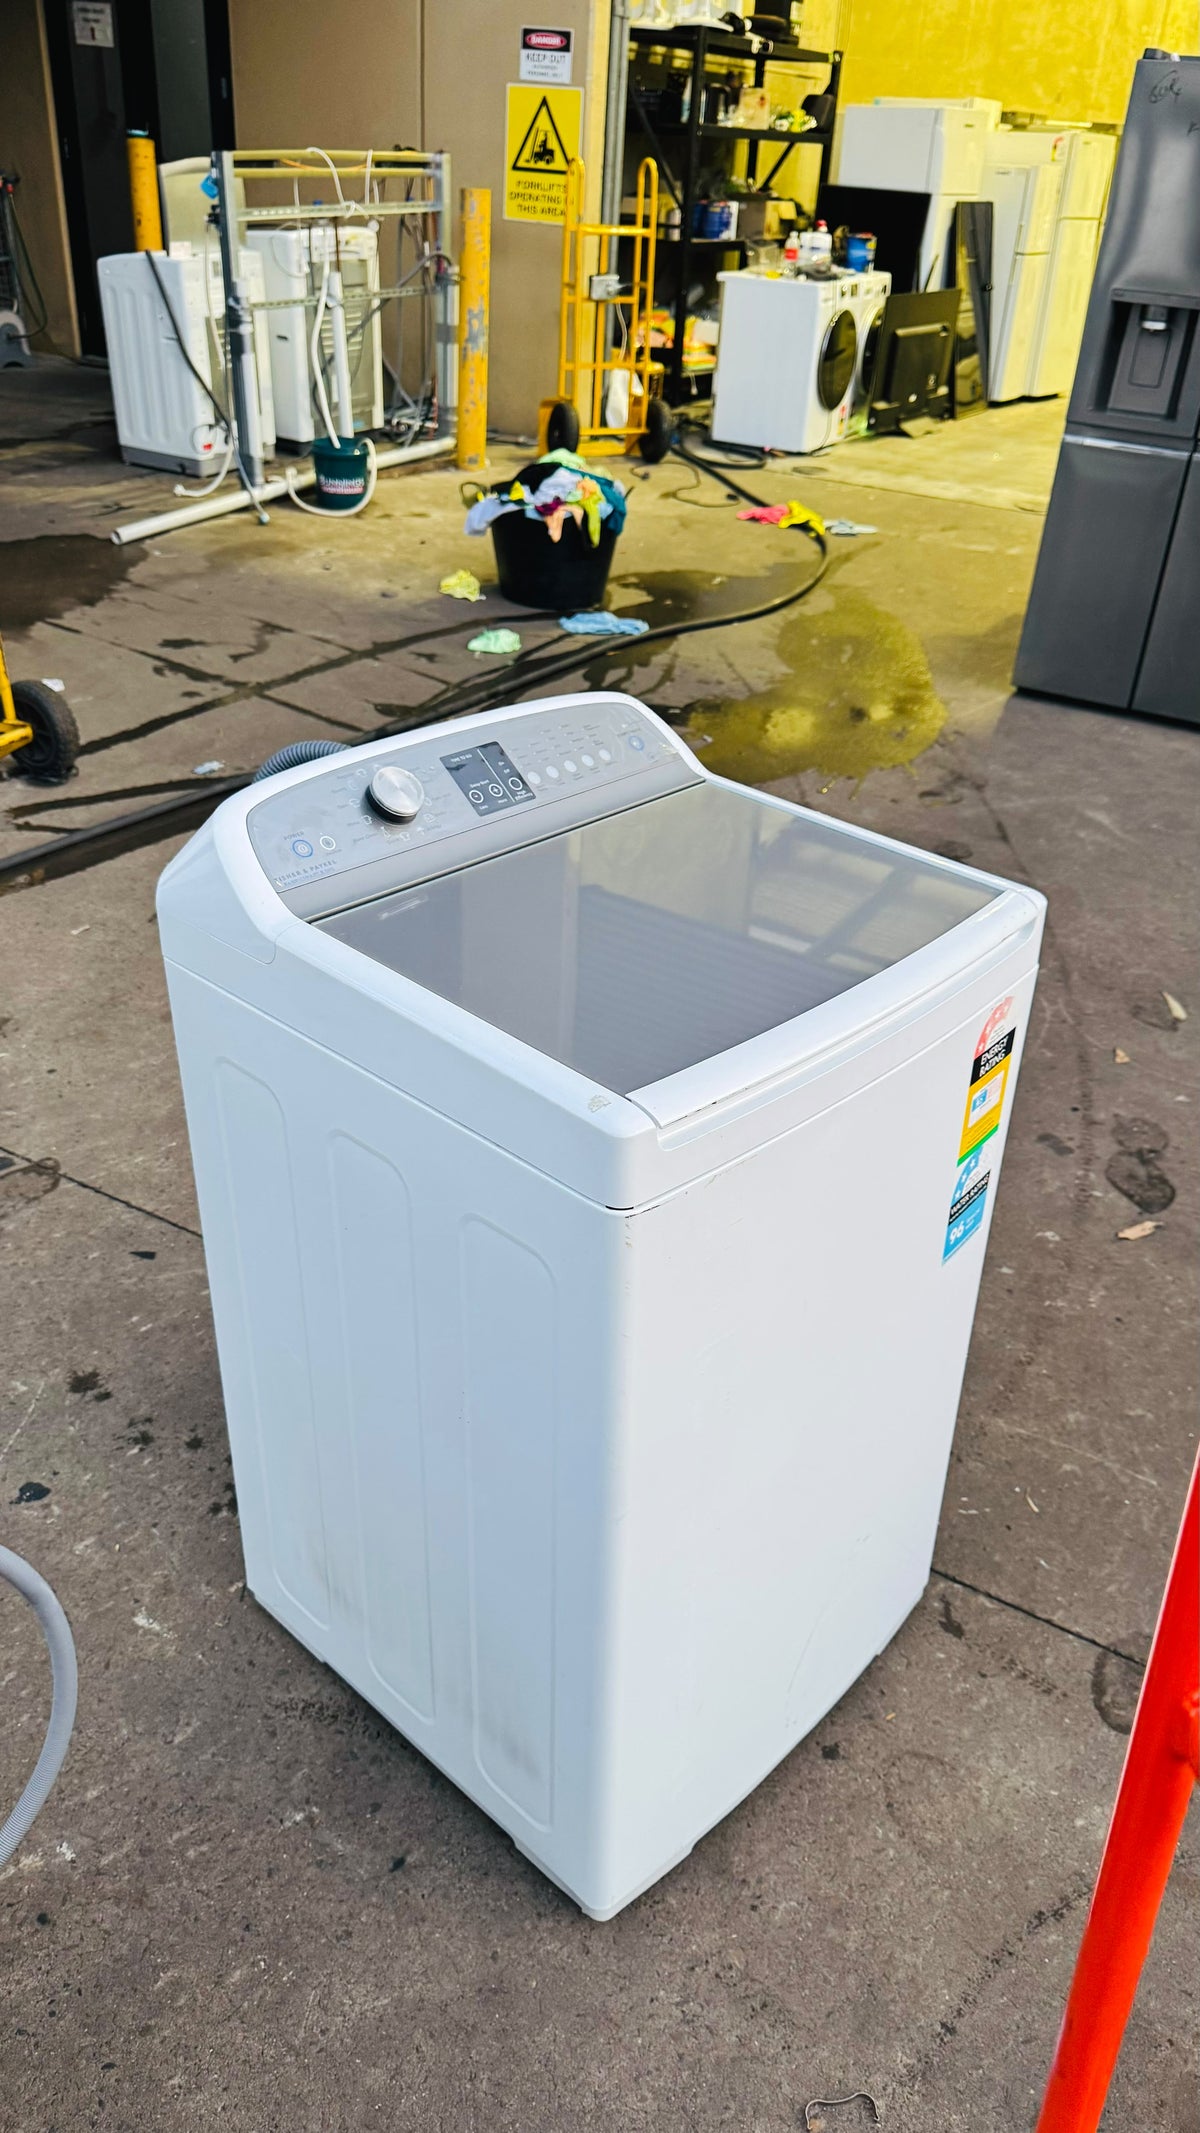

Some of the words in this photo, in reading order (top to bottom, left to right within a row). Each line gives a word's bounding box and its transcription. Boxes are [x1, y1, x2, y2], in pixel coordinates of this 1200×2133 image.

[526, 52, 546, 62] KEEP
[550, 54, 566, 63] OUT
[516, 180, 568, 193] FORKLIFTS
[517, 204, 538, 214] THIS
[309, 859, 338, 872] PAYKEL
[980, 1035, 1009, 1065] ENERGY
[979, 1049, 1006, 1077] RATING
[949, 1219, 965, 1245] 96
